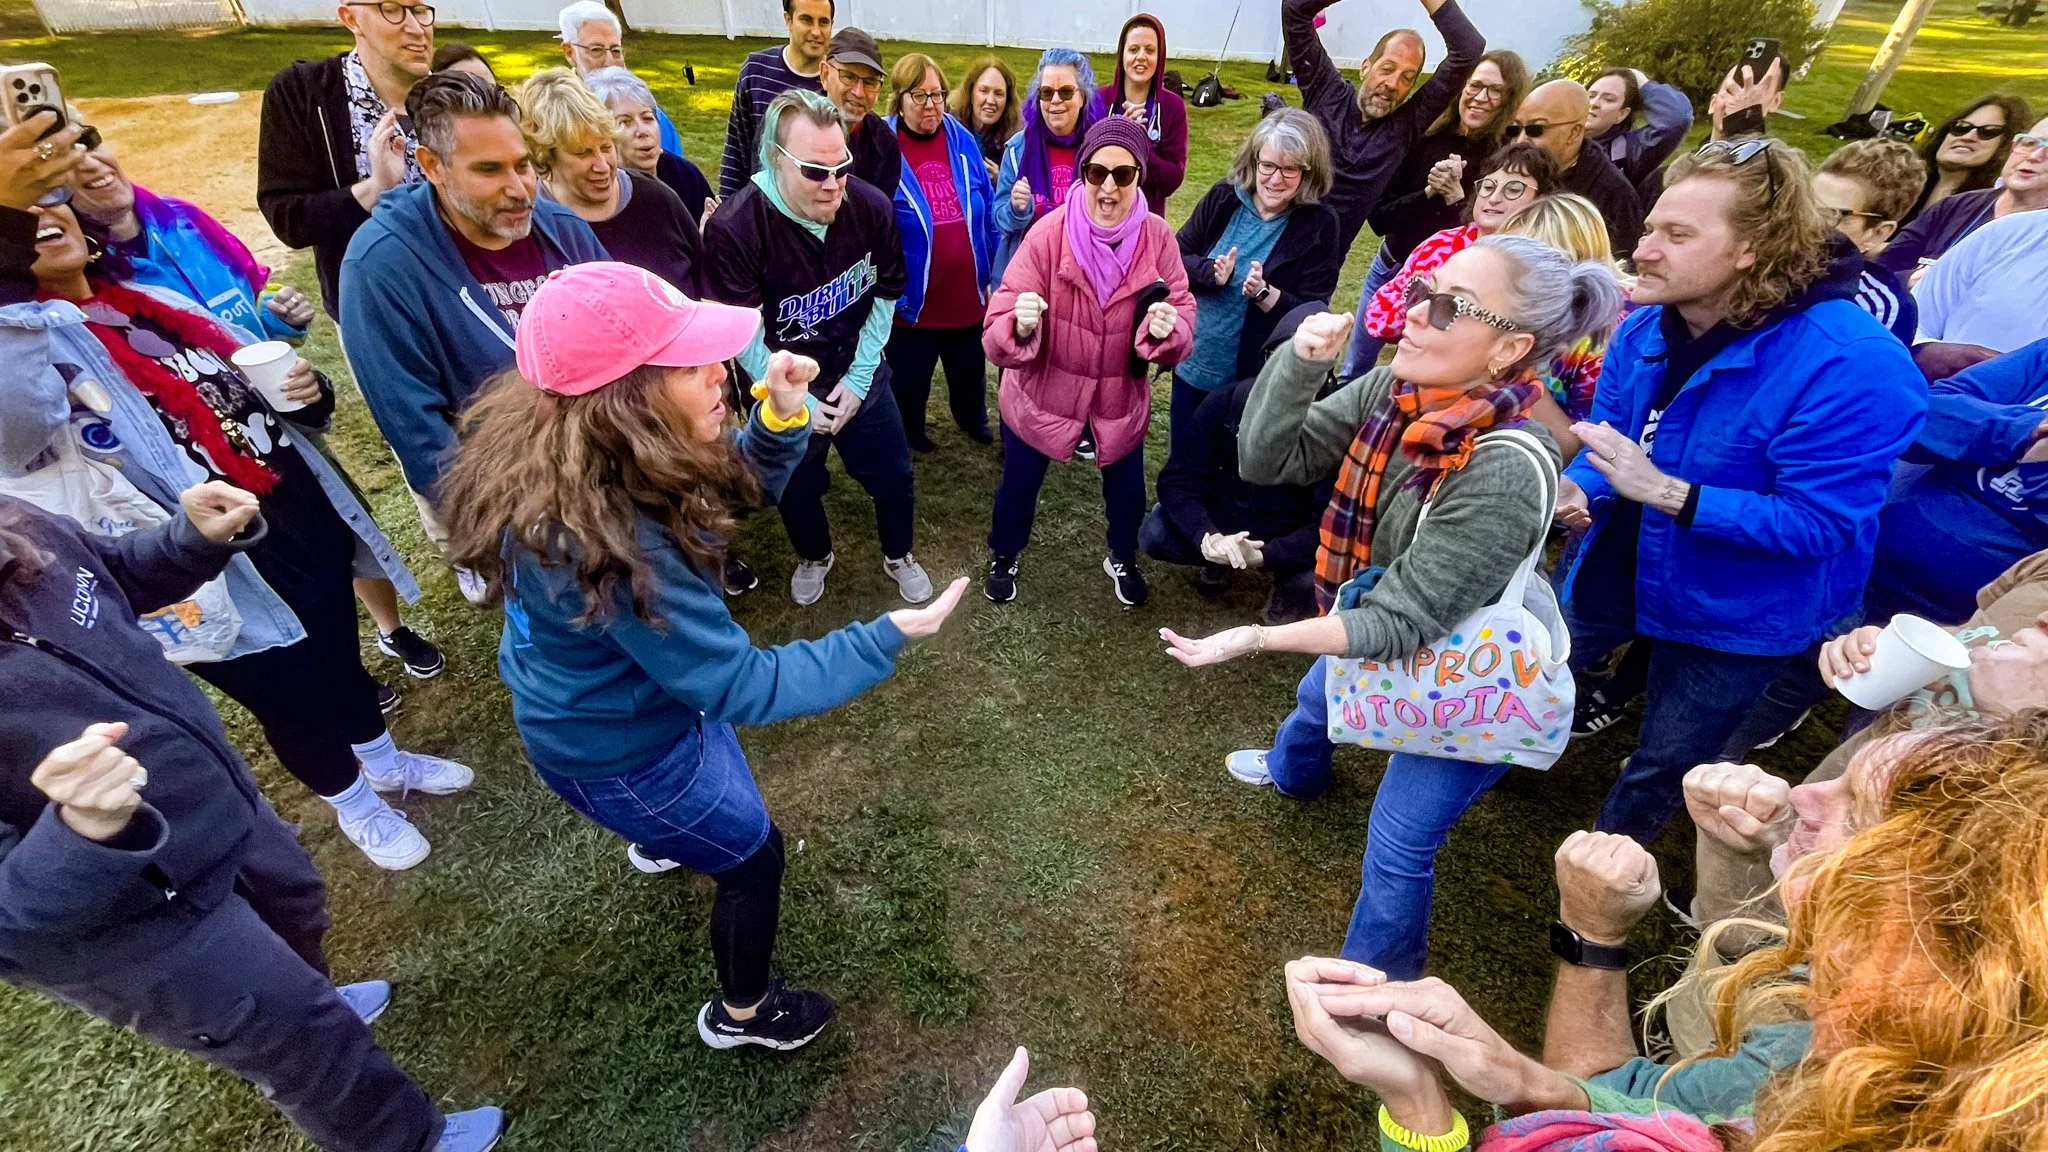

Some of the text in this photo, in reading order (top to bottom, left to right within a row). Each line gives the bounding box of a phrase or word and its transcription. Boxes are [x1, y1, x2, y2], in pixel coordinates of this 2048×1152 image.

[932, 197, 959, 218] EAS
[776, 252, 872, 322] DURHAM
[807, 265, 878, 329] BULLS
[70, 566, 95, 626] UCONN
[1342, 684, 1543, 733] UTOPIA
